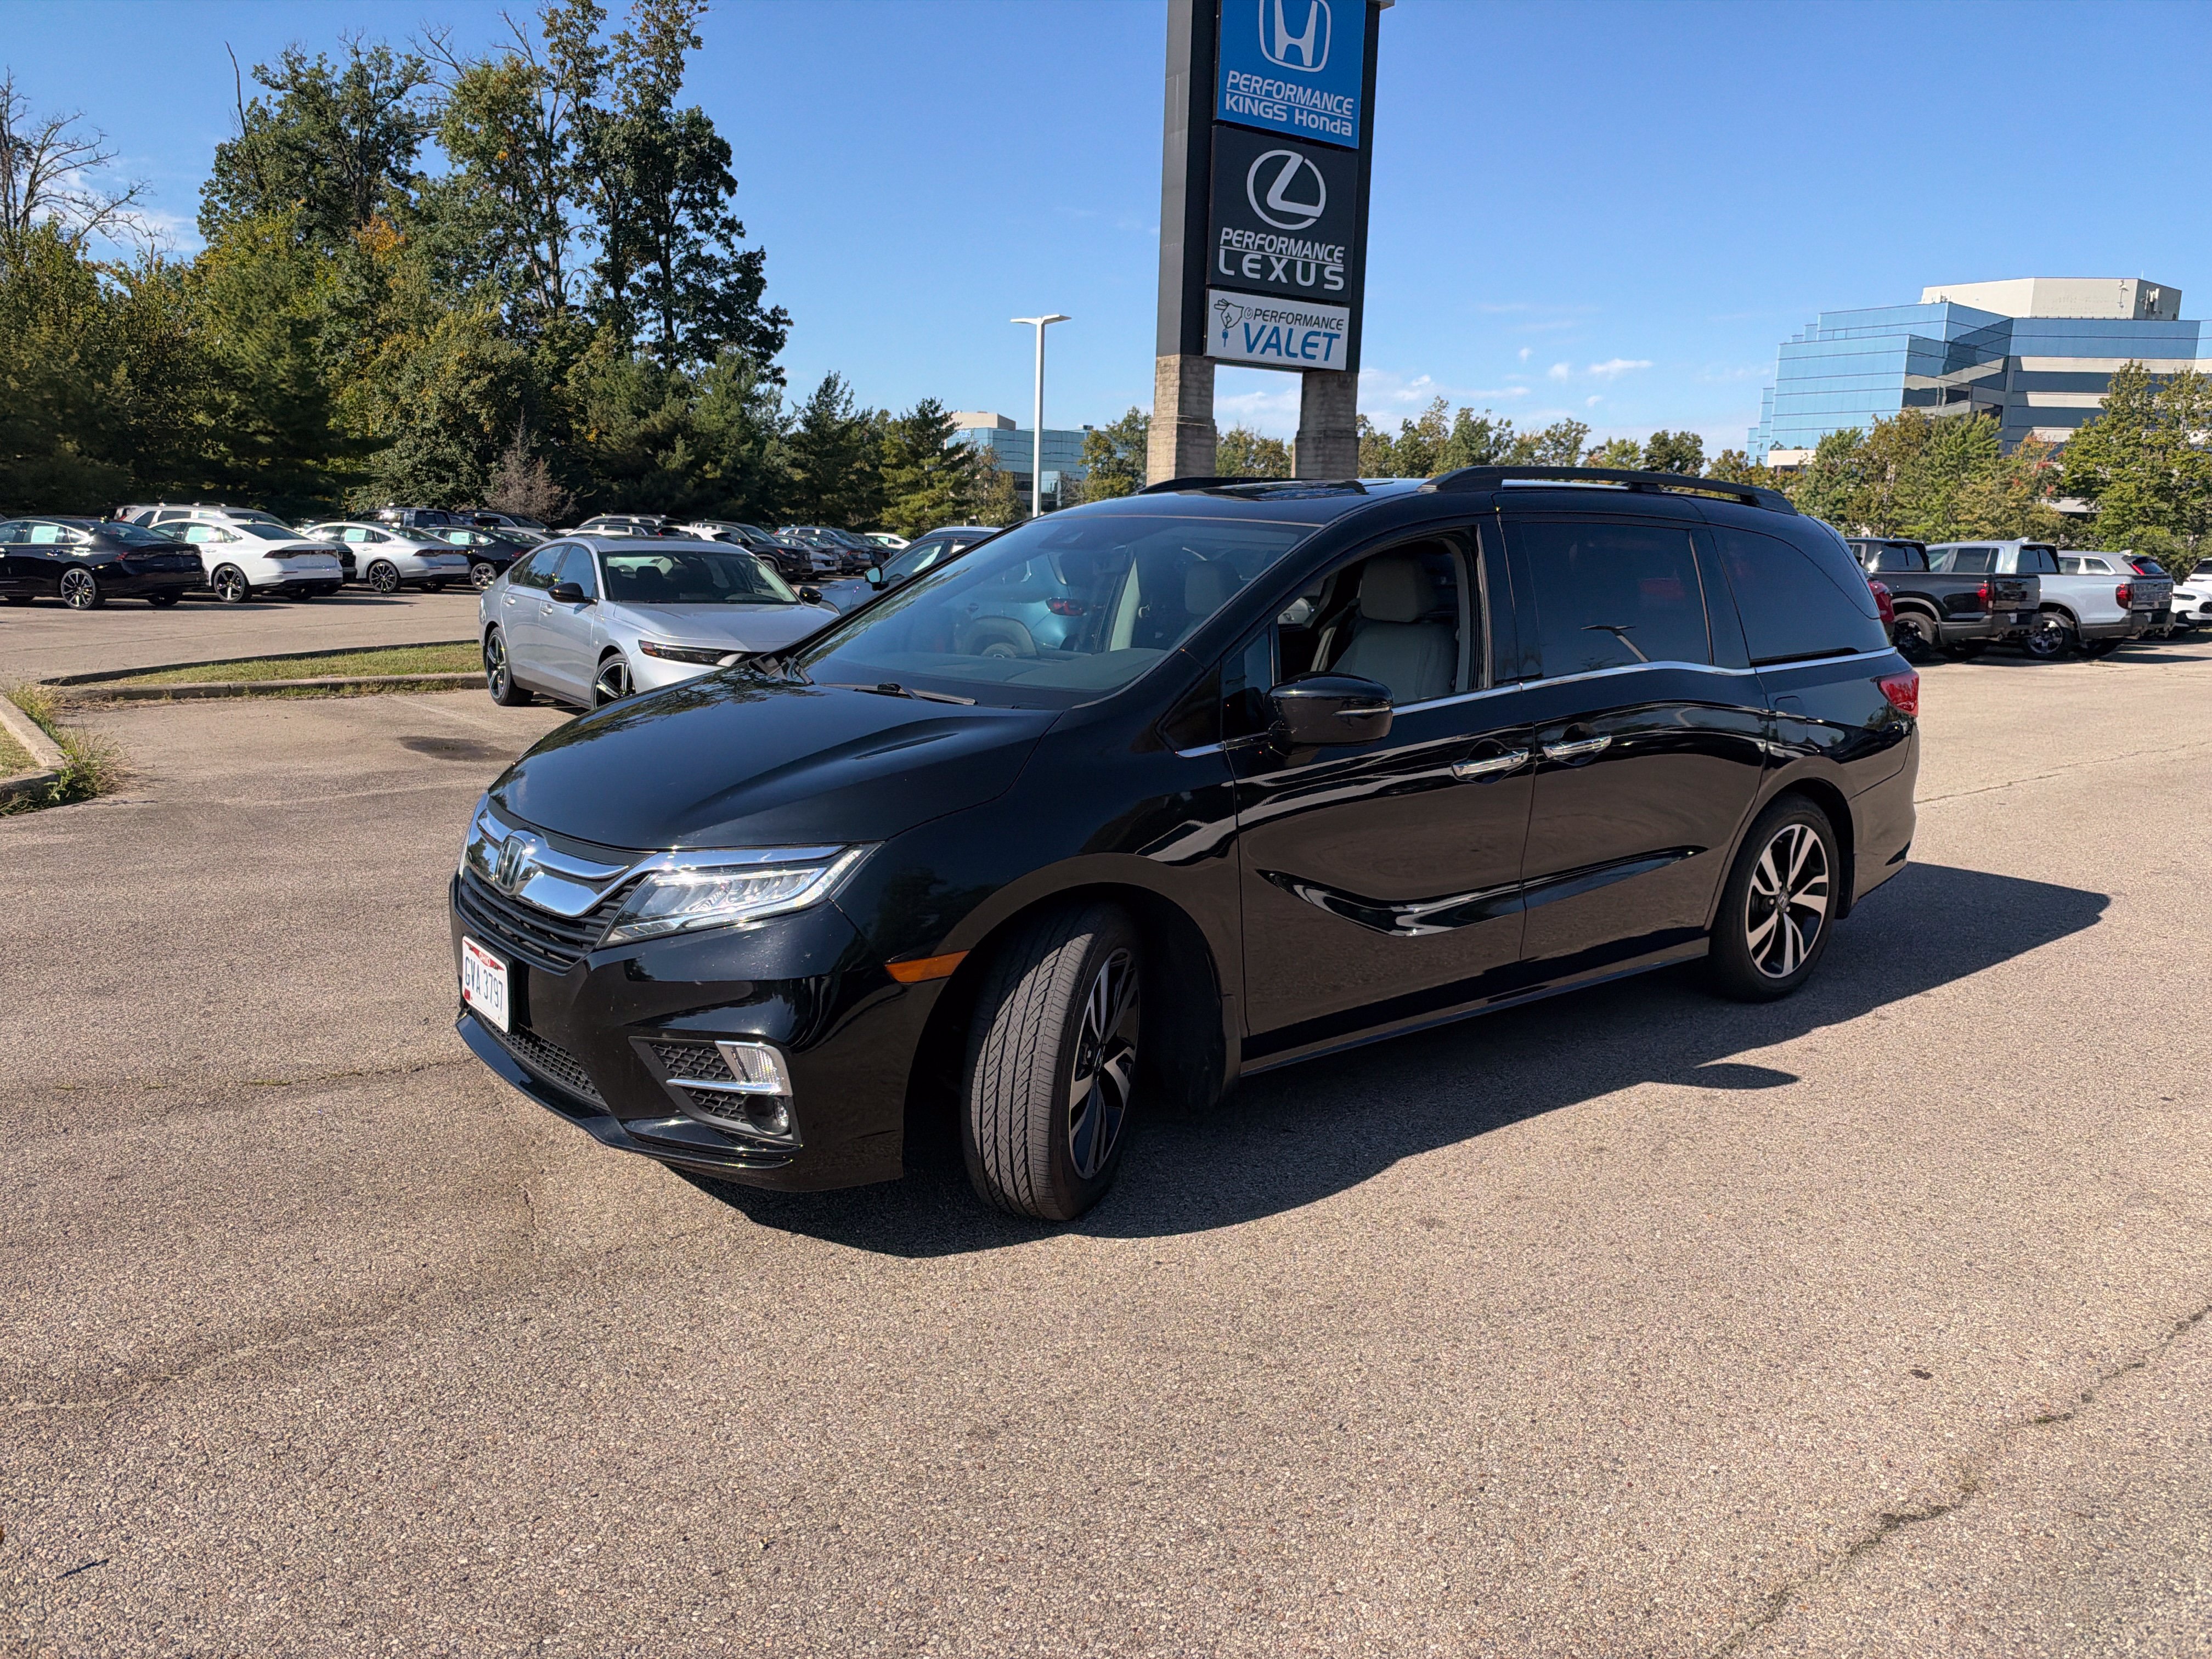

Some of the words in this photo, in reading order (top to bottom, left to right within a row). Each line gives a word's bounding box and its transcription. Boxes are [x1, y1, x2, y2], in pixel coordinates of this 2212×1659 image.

[1227, 70, 1354, 115] PERFORMANCE
[1226, 93, 1288, 122] KINGS
[1294, 108, 1352, 137] Honda
[1220, 227, 1346, 263] PERFORMANCE
[1218, 249, 1345, 291] LEXUS
[1253, 308, 1345, 331] PERFORMANCE
[1243, 322, 1341, 362] VALET
[478, 951, 491, 966] OHIO
[465, 956, 481, 995] GVA
[483, 969, 503, 1012] 3797
